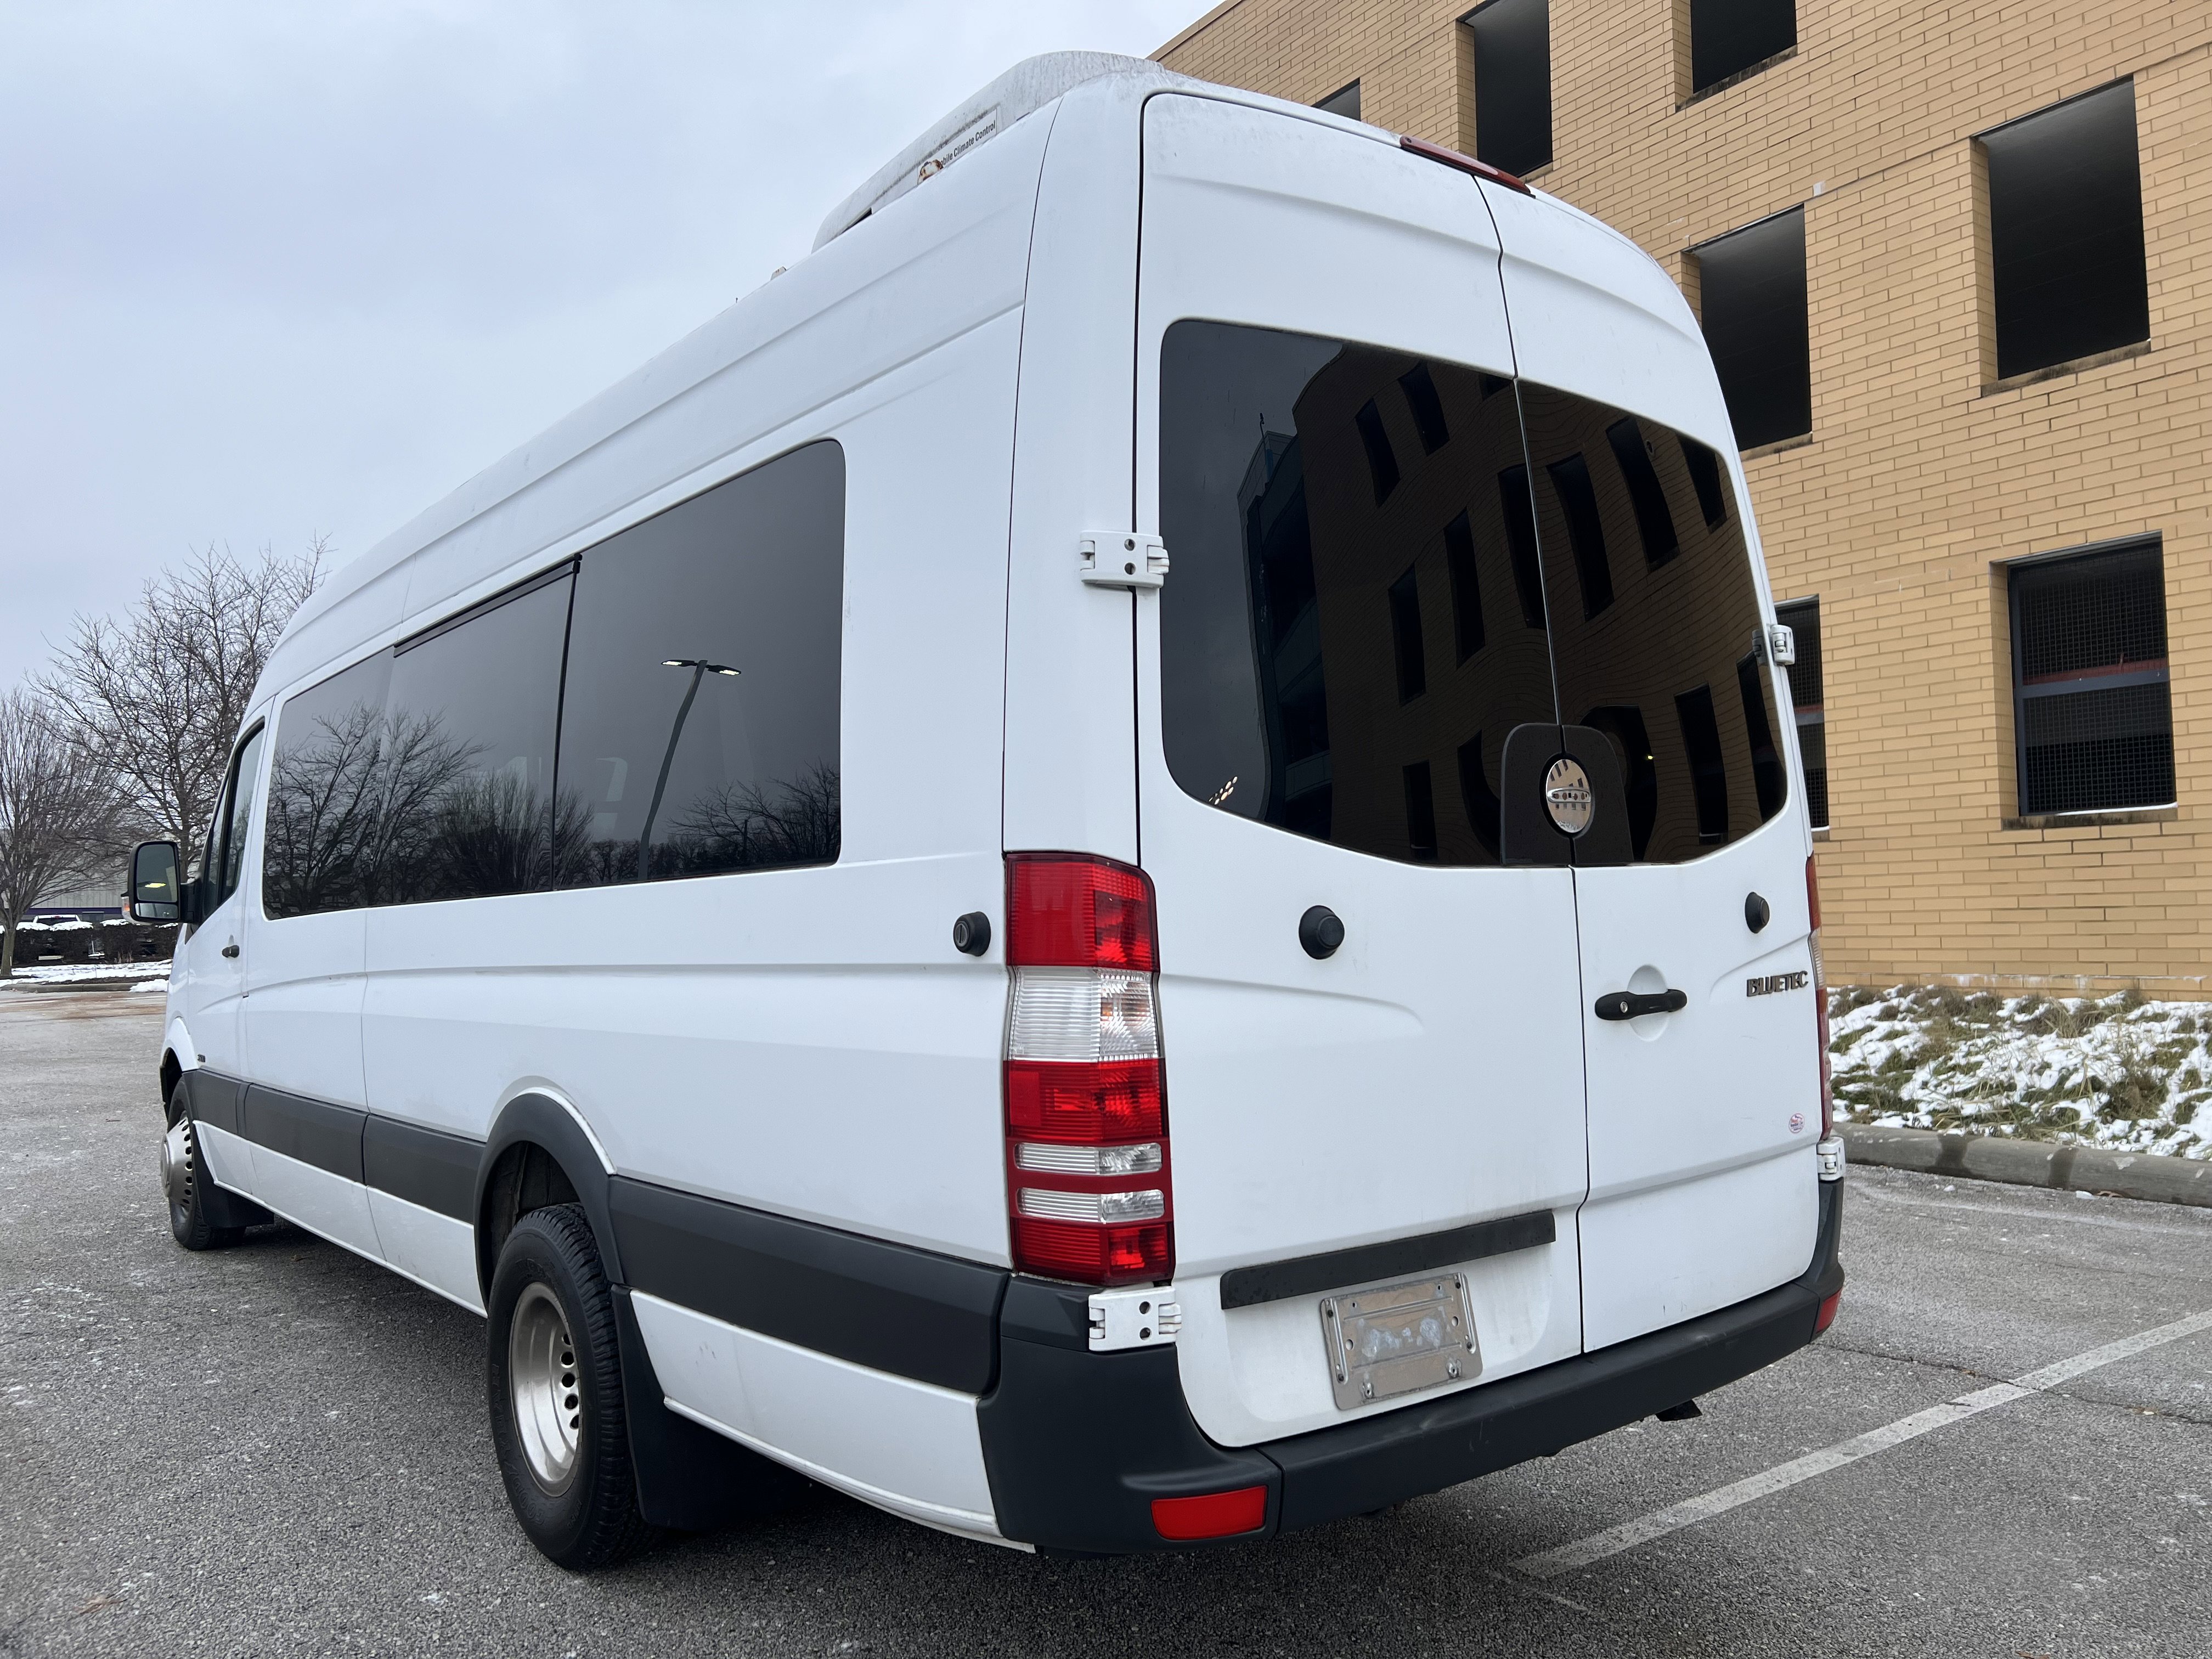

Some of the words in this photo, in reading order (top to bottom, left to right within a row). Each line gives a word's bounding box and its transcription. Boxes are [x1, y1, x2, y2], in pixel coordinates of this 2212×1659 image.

[940, 153, 953, 166] obile
[953, 137, 974, 157] Climate
[975, 120, 995, 142] Control
[1747, 970, 1808, 996] BLUETEC
